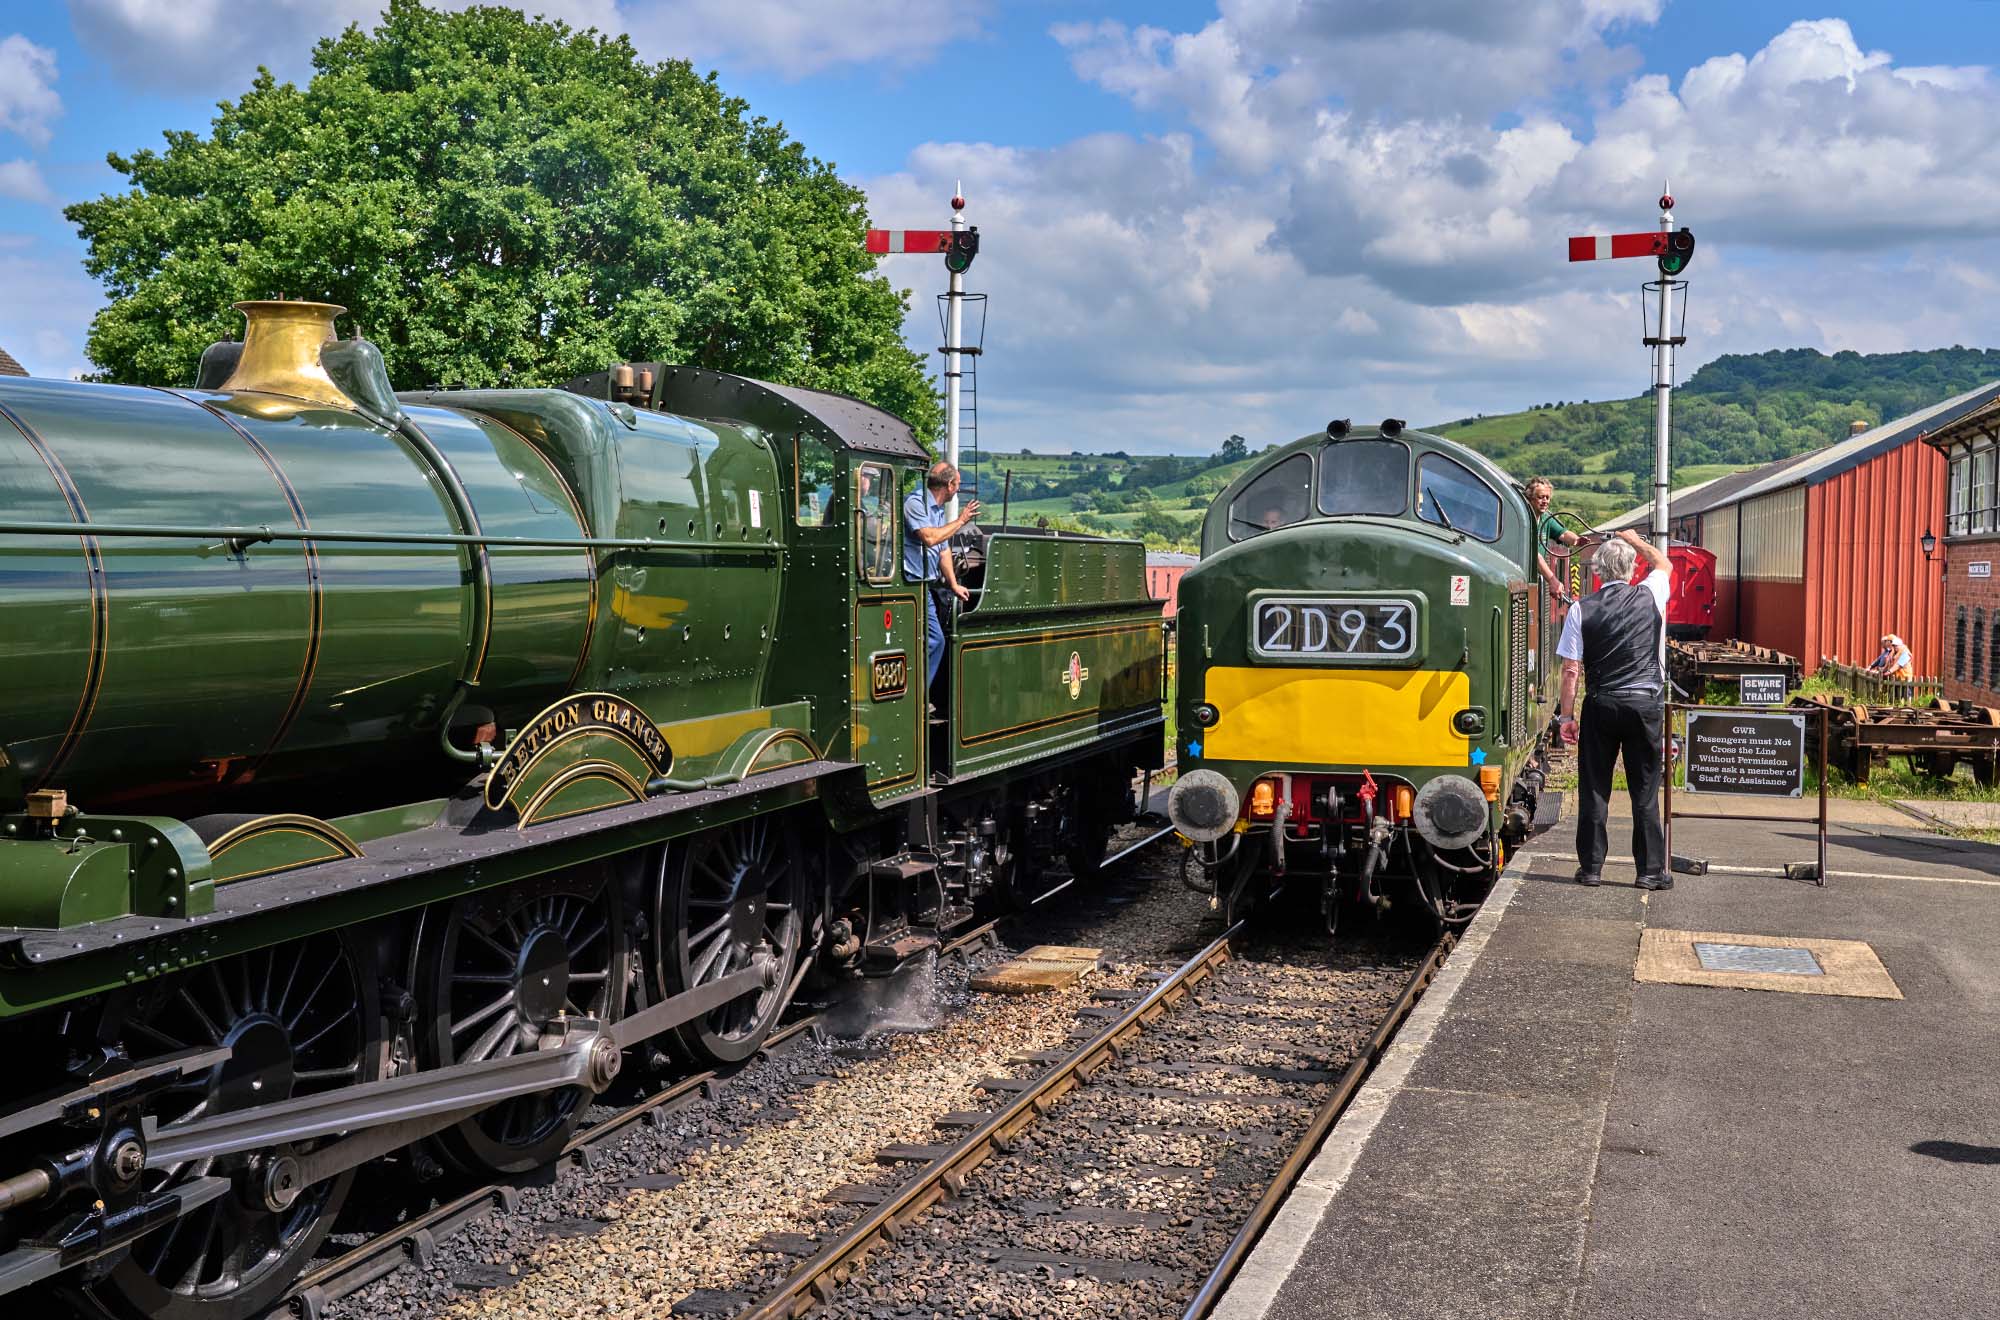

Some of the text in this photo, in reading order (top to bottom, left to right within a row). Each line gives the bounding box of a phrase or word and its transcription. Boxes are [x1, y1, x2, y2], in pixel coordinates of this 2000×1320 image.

[1264, 606, 1406, 652] 2D93
[876, 660, 904, 689] 6880
[1744, 680, 1782, 688] BEWARE
[1732, 726, 1756, 734] GWR
[502, 700, 665, 786] BETTON GRANGE
[1696, 735, 1747, 746] Passengers
[1699, 755, 1788, 766] Without Permission
[1748, 767, 1784, 775] member
[1722, 775, 1736, 783] for
[1738, 777, 1787, 786] Assistance
